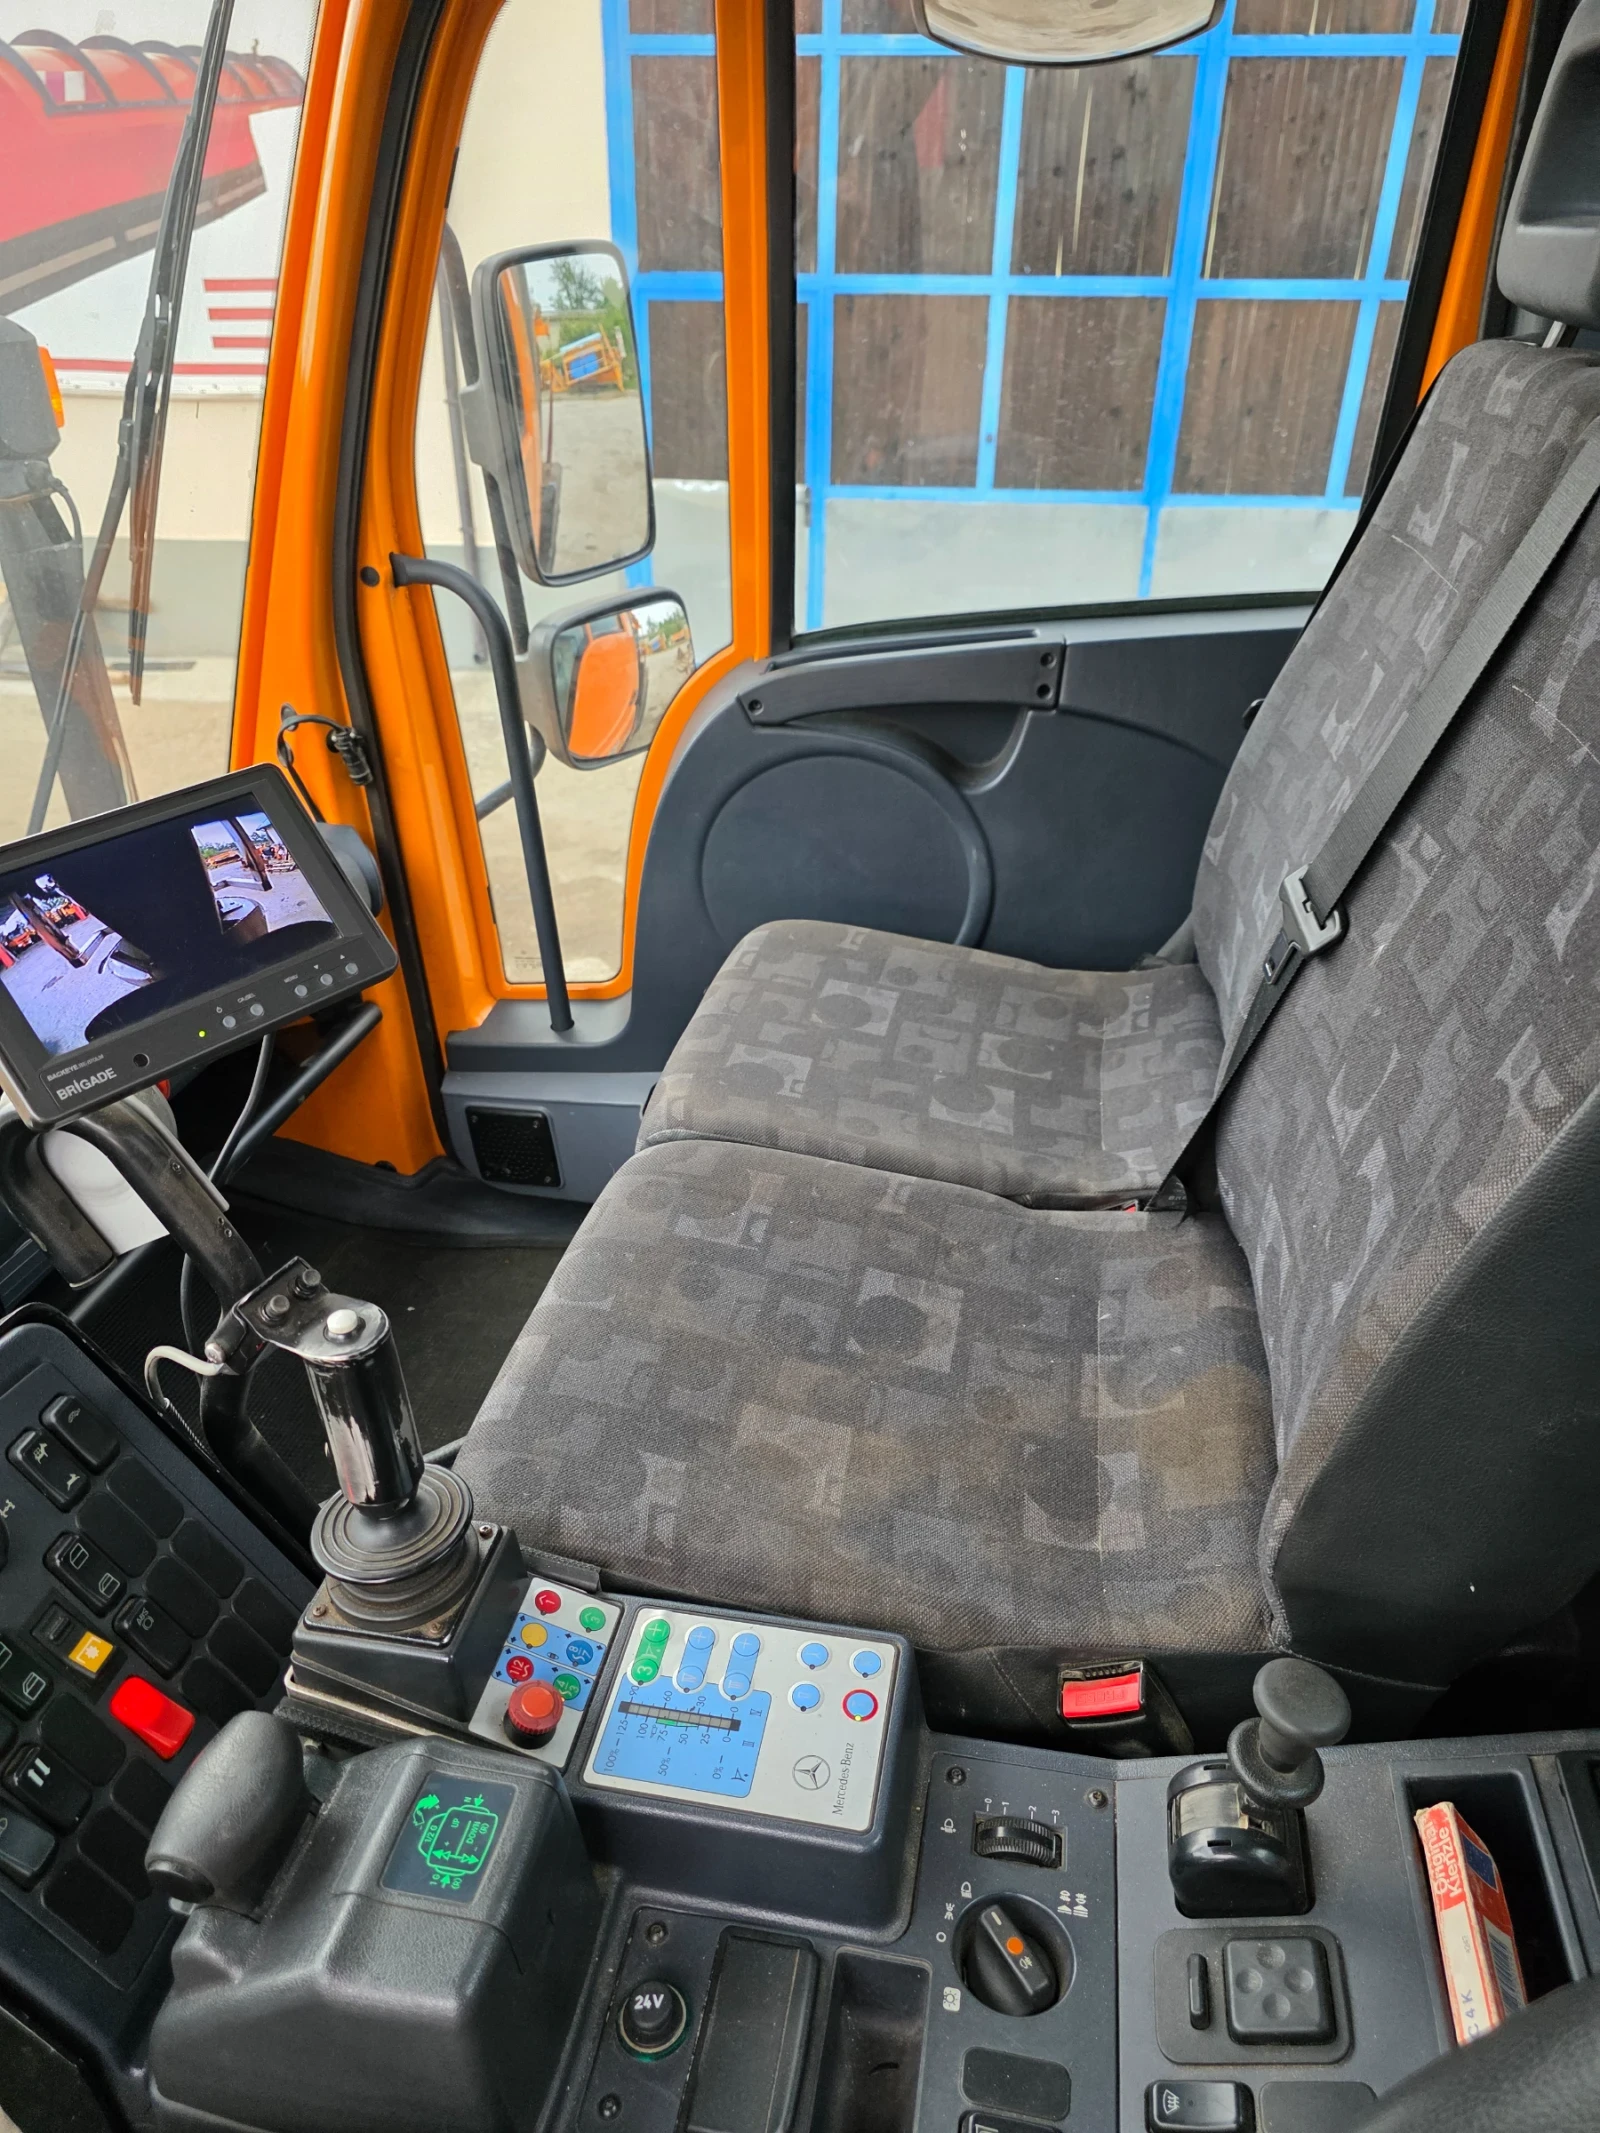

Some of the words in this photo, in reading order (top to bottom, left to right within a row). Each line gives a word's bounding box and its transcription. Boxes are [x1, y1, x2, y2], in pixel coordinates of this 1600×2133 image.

[46, 1063, 79, 1082] BACKEYE
[55, 1067, 118, 1101] BRIGADE
[136, 1607, 149, 1627] ABS
[629, 1685, 640, 1697] 90
[664, 1690, 673, 1703] 60
[695, 1695, 707, 1708] 30
[616, 1719, 629, 1736] 125
[636, 1723, 649, 1740] 100
[657, 1729, 669, 1742] 75
[678, 1733, 689, 1746] 50
[700, 1733, 711, 1745] 25
[604, 1748, 620, 1773] 100%
[658, 1756, 671, 1777] 50%
[712, 1766, 724, 1780] 0%
[832, 1742, 855, 1816] Mercedes-Benz
[450, 1817, 460, 1828] UP
[465, 1821, 481, 1845] DOWN
[1438, 1826, 1463, 1898] Kienzle
[633, 1993, 665, 2010] 24V
